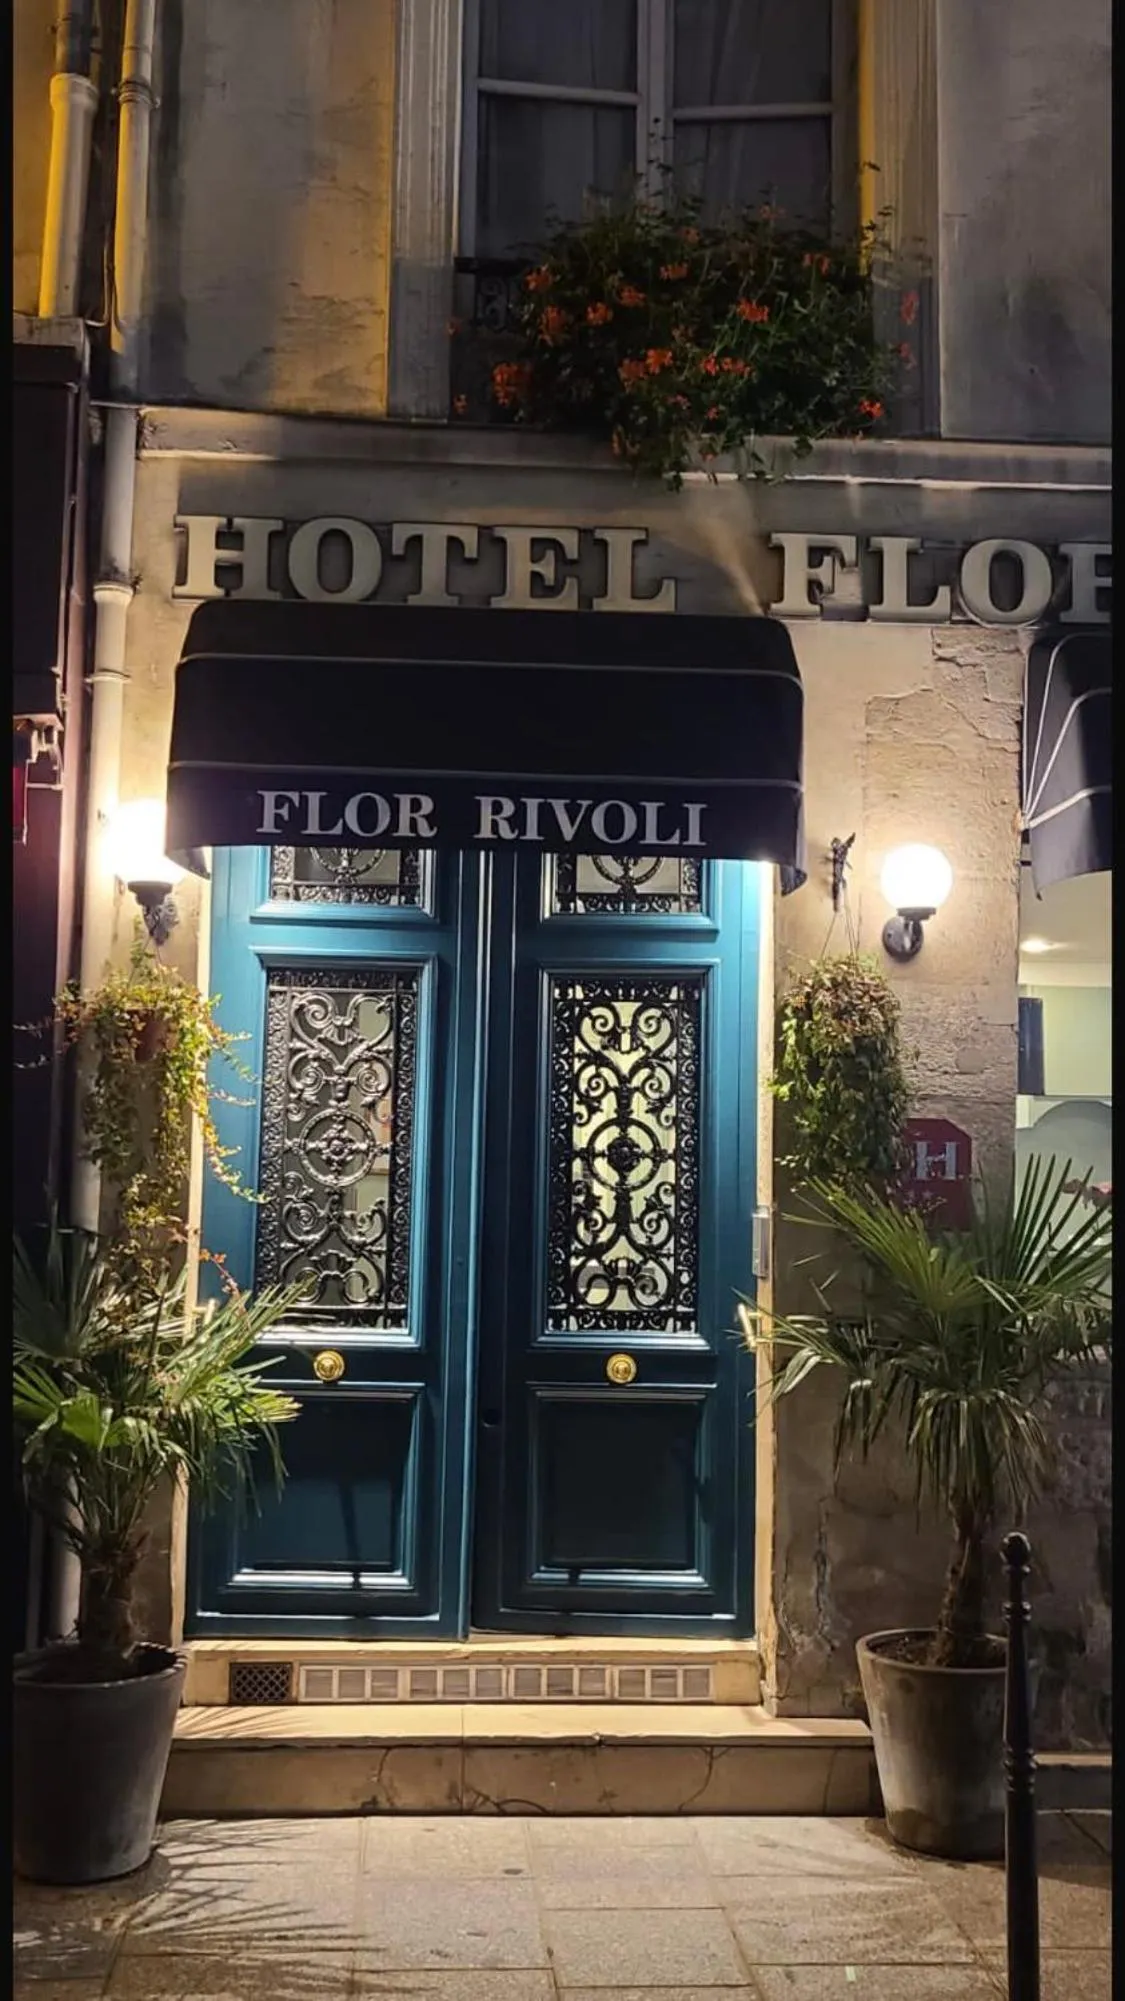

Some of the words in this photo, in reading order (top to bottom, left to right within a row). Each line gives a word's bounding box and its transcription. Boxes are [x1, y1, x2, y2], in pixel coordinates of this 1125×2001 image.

[173, 514, 677, 612] HOTEL
[256, 790, 437, 838] FLOR
[473, 795, 707, 846] RIVOLI
[914, 1141, 959, 1181] H
